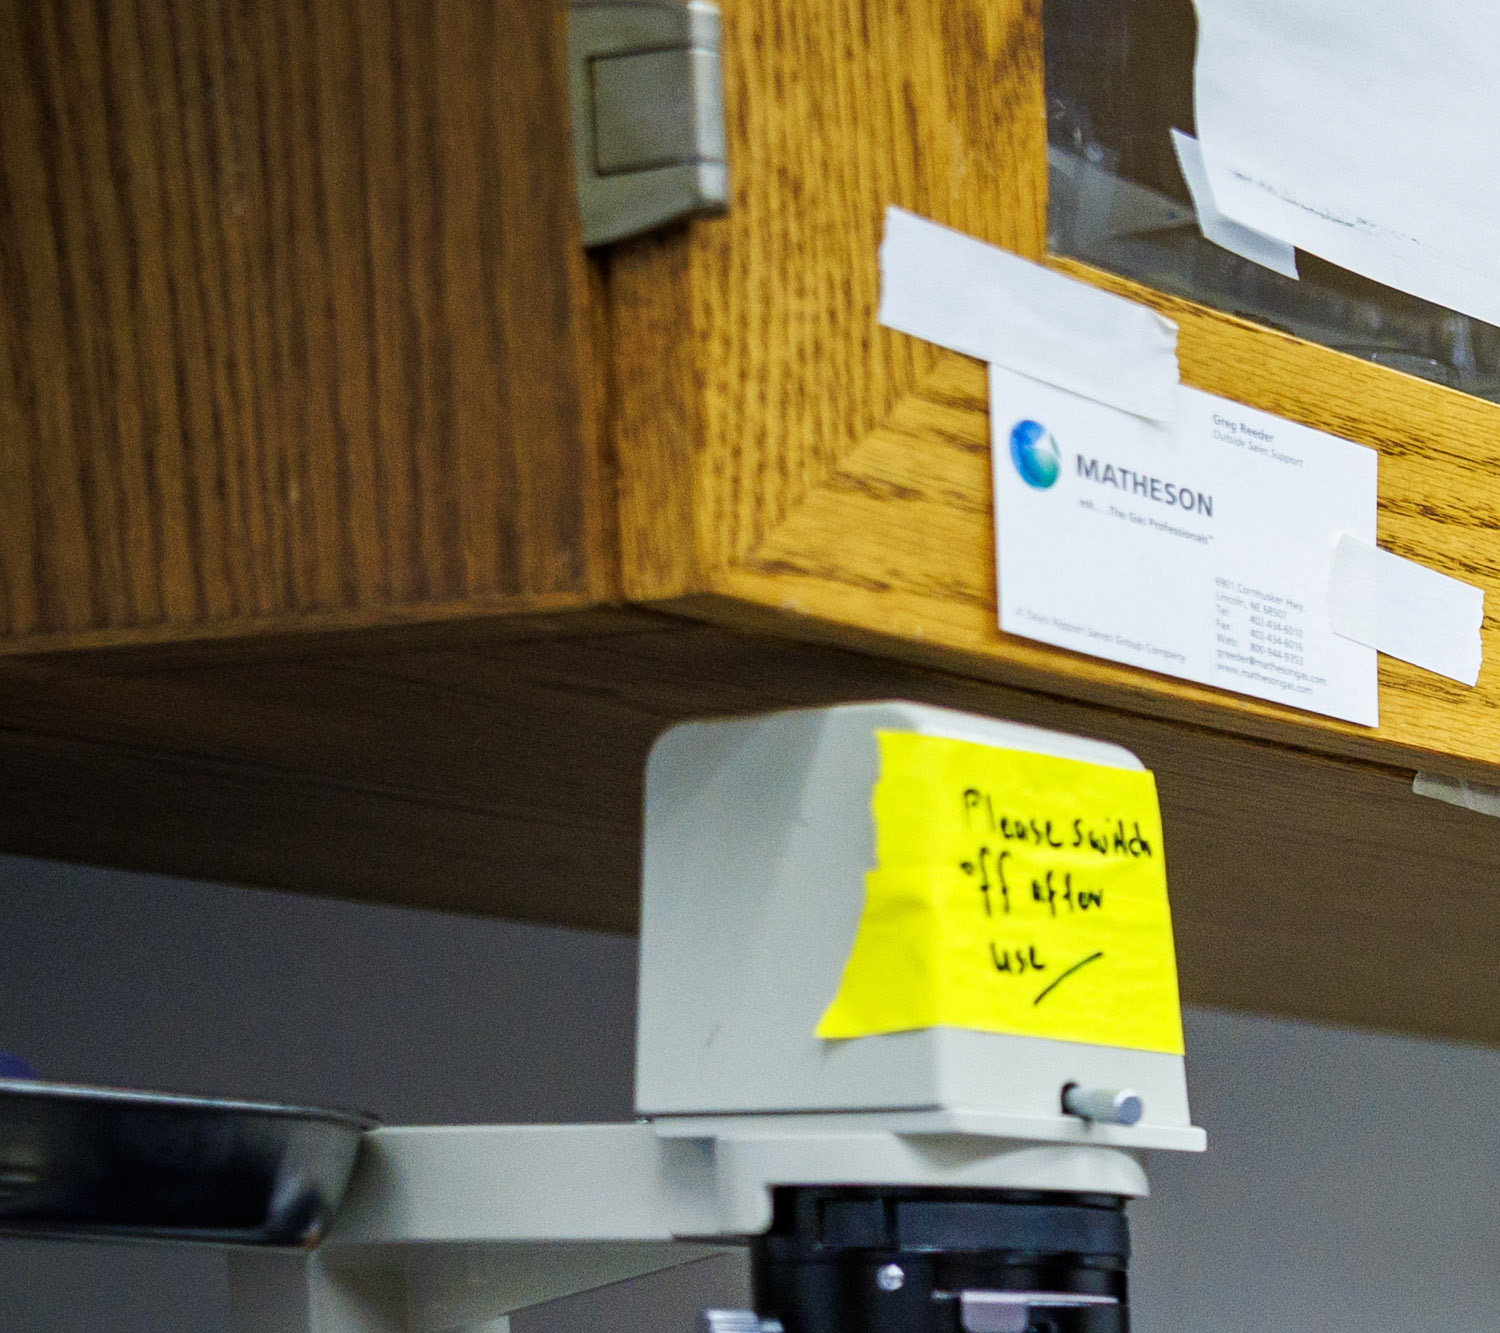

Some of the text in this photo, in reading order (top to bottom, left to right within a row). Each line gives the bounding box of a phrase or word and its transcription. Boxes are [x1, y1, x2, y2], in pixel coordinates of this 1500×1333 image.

[1213, 414, 1274, 442] Greg Reeder
[1271, 449, 1304, 467] Support
[1076, 454, 1214, 519] MATHESON
[1238, 583, 1283, 604] Cornhusker
[1250, 601, 1261, 613] NE
[1216, 648, 1328, 686] greeder@mathesongas.com
[1217, 663, 1314, 695] www.mathesongas.com
[962, 787, 1153, 860] Please switch
[1031, 870, 1104, 918] after
[988, 941, 1048, 975] use
